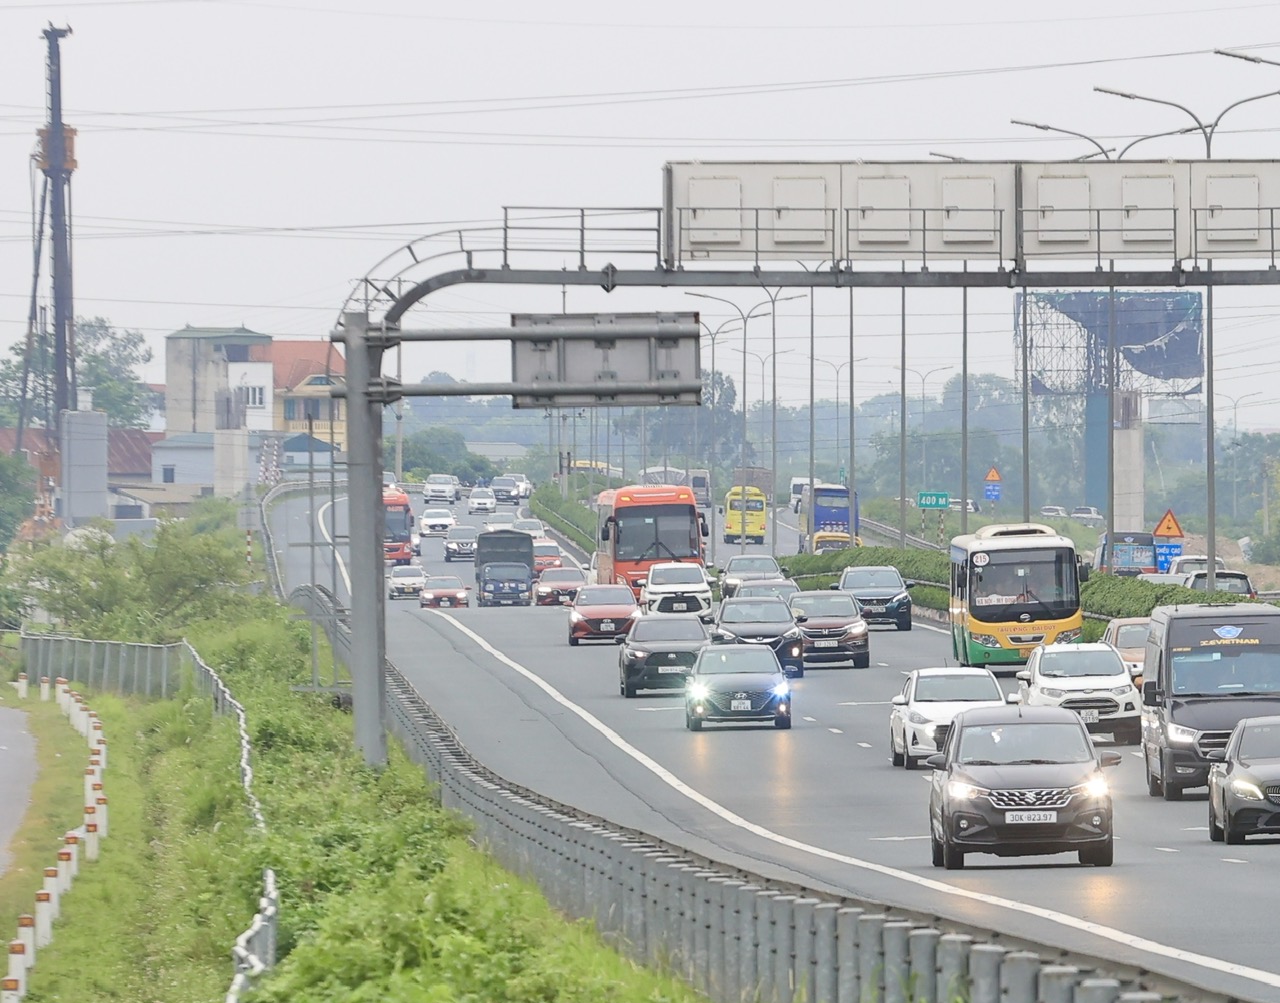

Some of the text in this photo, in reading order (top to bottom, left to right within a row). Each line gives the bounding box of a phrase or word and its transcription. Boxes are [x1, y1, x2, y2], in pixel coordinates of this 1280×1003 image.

[921, 496, 946, 505] 400 M
[974, 555, 987, 563] 215
